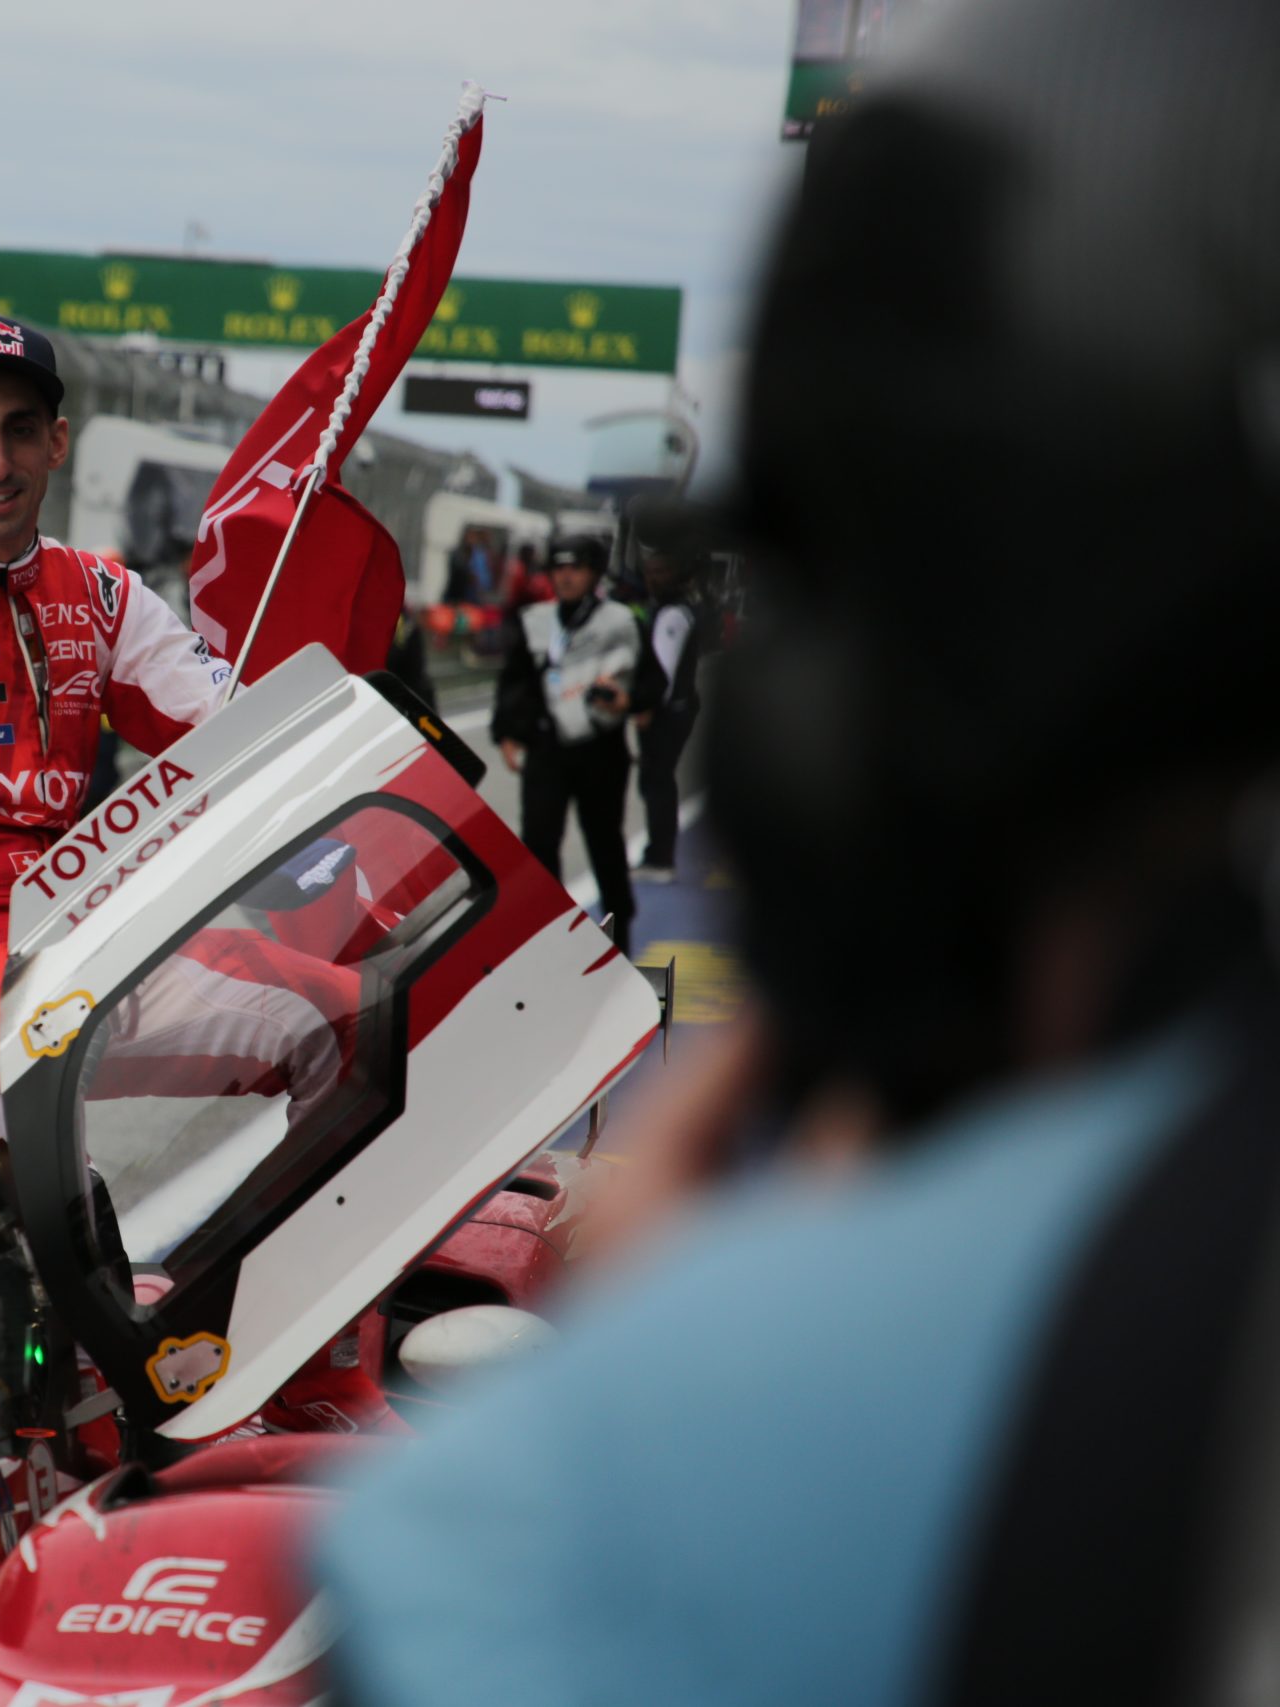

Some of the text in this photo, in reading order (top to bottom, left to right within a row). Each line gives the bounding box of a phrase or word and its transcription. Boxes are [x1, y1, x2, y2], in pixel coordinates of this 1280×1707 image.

[60, 302, 171, 332] ROLEX
[224, 312, 337, 341] ROLEX
[522, 328, 638, 362] ROLEX
[48, 639, 97, 662] ZENT
[22, 759, 195, 900] TOYOTA
[57, 1603, 268, 1647] EDIFICE
